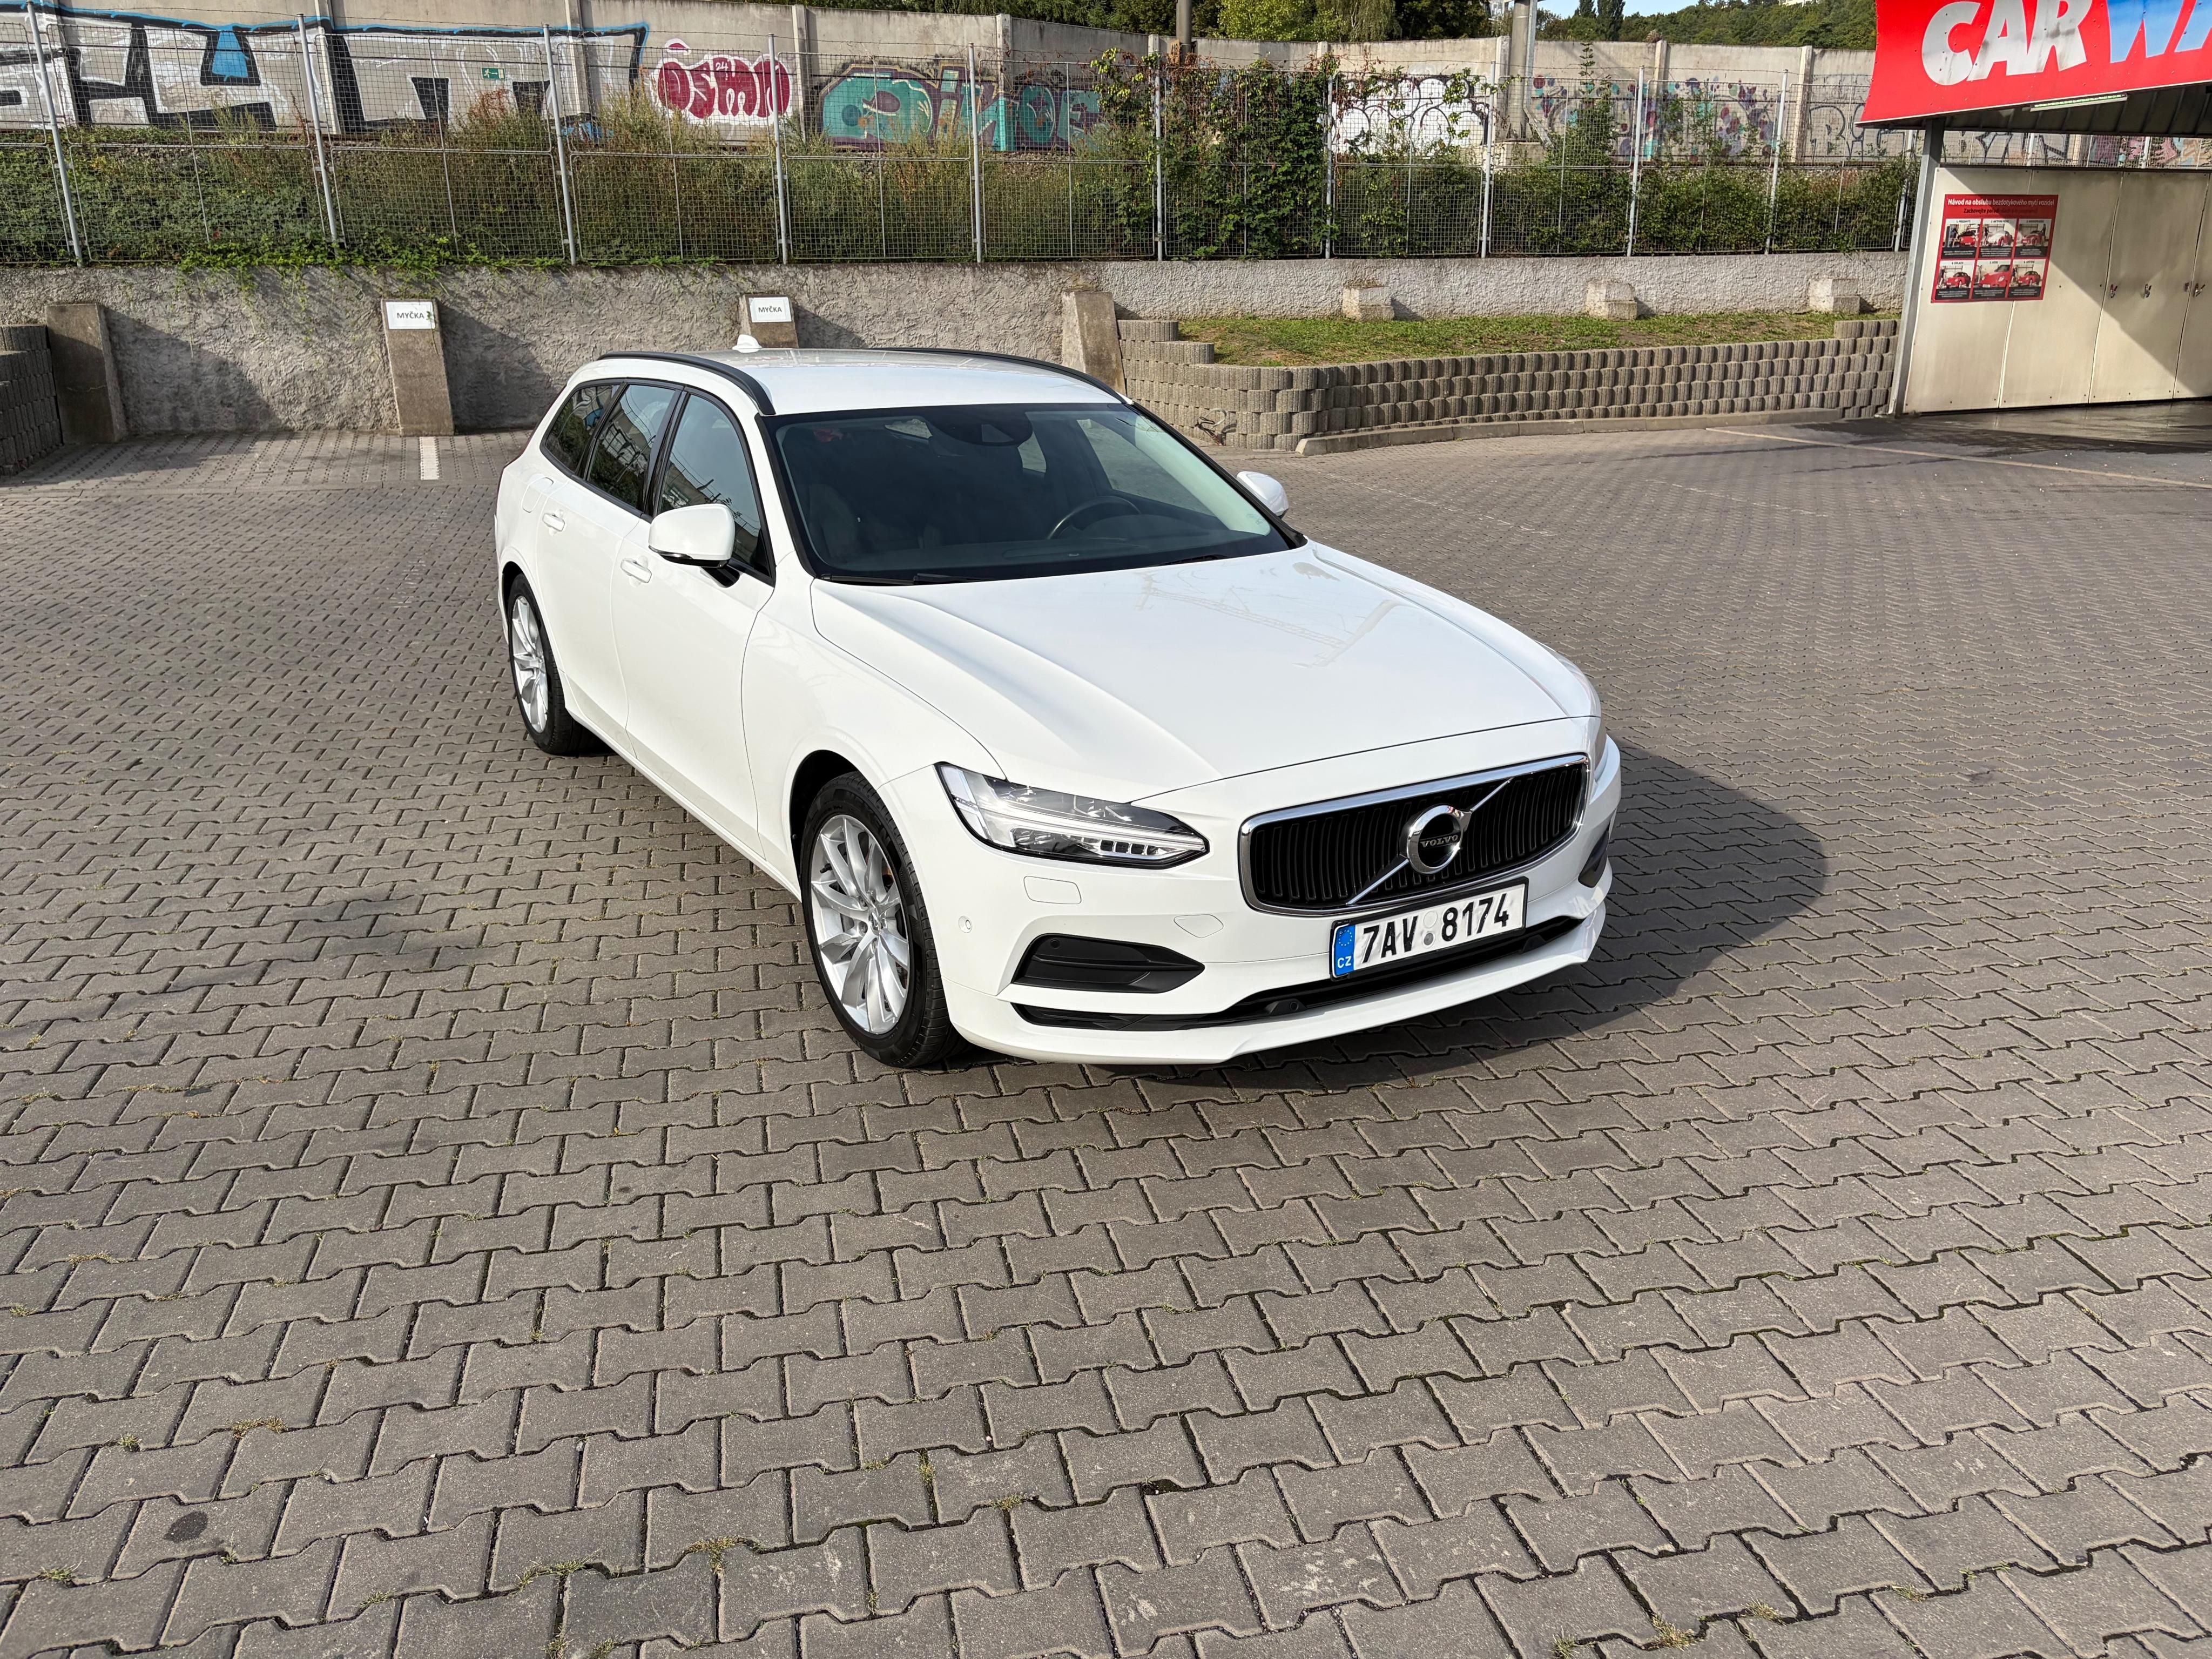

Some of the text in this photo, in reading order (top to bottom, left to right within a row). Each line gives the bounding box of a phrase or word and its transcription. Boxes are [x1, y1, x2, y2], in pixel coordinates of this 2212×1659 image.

[1921, 0, 2092, 86] CAR
[1992, 198, 2027, 206] bezdotykového
[397, 311, 424, 319] MYČKA
[1420, 834, 1459, 848] VOLVO
[1361, 893, 1509, 964] 7AV 8174
[1337, 955, 1352, 968] CZ
